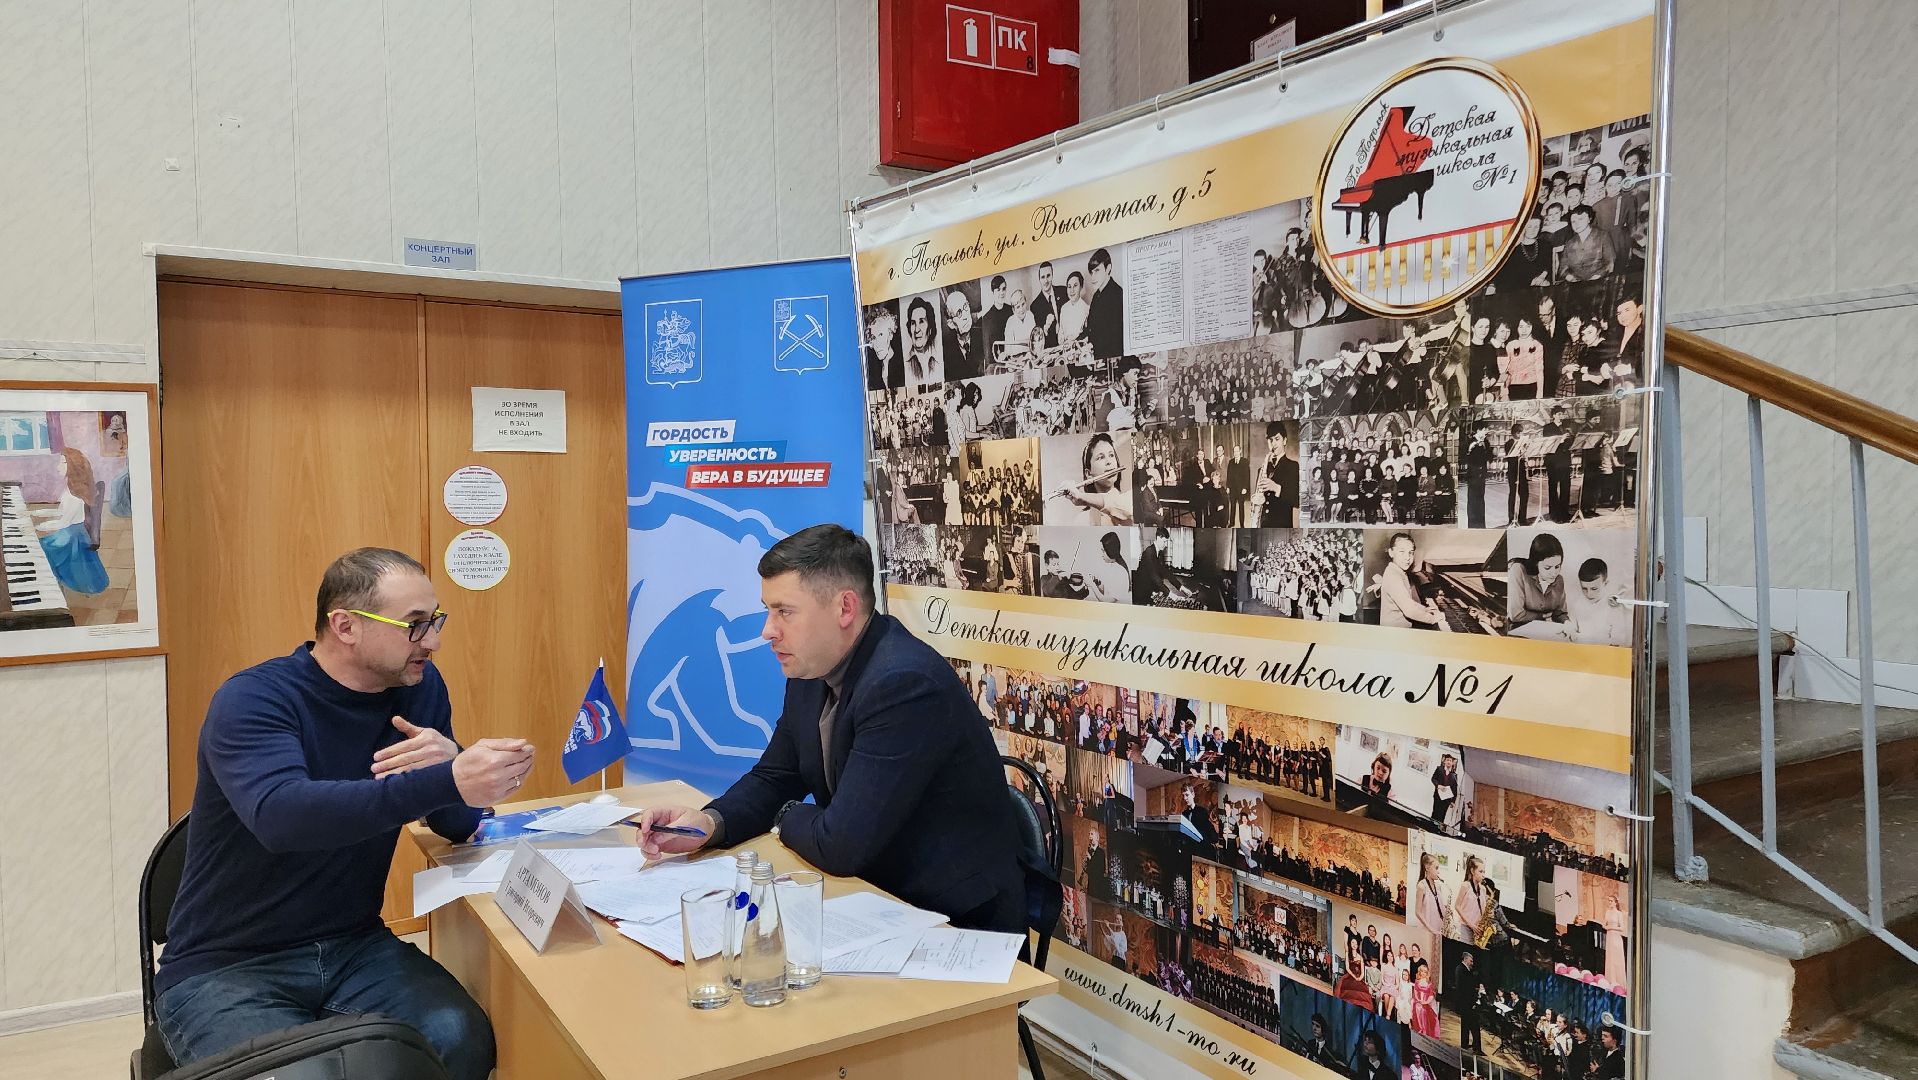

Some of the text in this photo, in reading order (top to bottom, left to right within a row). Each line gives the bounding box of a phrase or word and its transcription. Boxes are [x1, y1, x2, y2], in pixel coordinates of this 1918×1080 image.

[998, 26, 1028, 52] ПК
[1026, 56, 1034, 71] 8
[1406, 105, 1497, 147] Детская
[1395, 126, 1515, 174] музыкальная
[1436, 148, 1497, 177] школа
[902, 229, 990, 281] Подольск,
[993, 233, 1025, 266] ул.
[1031, 193, 1166, 242] Высотная,
[407, 243, 473, 256] КОНЦЕРТНЫЙ
[431, 255, 450, 264] ЗАЛ
[494, 410, 544, 418] ИСПОЛНЕНИЯ
[509, 429, 543, 438] ВХОДИТЬ
[652, 427, 729, 443] ГОРДОСТЬ
[669, 447, 778, 463] УВЕРЕННОСТЬ
[691, 468, 826, 485] ВЕРА В БУДУЩЕЕ
[923, 595, 1031, 648] Детская
[1036, 623, 1247, 678] музыкальная
[1256, 643, 1395, 699] школа
